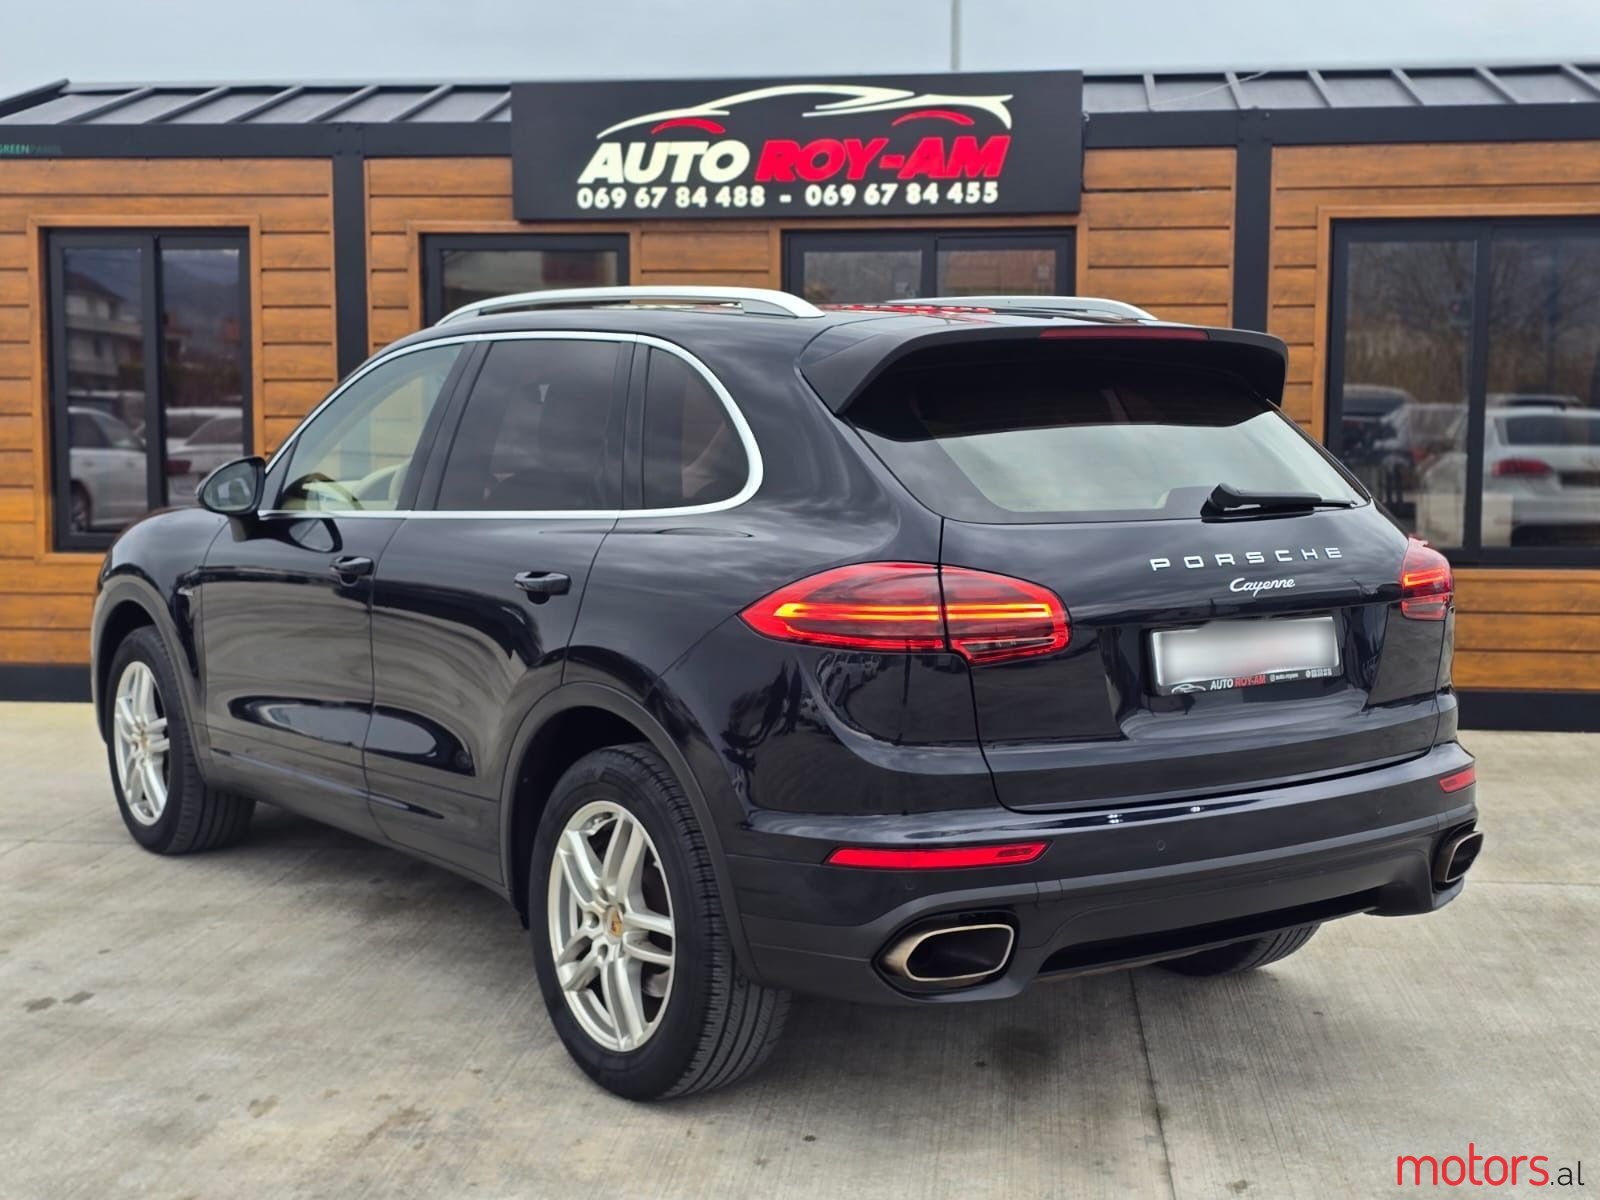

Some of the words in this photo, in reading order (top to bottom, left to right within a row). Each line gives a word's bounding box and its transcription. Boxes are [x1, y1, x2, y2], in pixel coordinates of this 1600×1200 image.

[576, 139, 750, 184] AUTO
[754, 135, 1011, 182] ROY-AM
[577, 187, 627, 209] 069
[634, 187, 668, 208] 67
[675, 186, 708, 208] 84
[715, 185, 766, 208] 488
[779, 194, 792, 203] -
[805, 184, 856, 206] 069
[864, 183, 898, 205] 67
[906, 182, 939, 205] 84
[947, 181, 998, 204] 455
[1150, 547, 1343, 571] PORSCHE
[1229, 577, 1296, 598] Cayenne
[1210, 679, 1234, 691] AUTO
